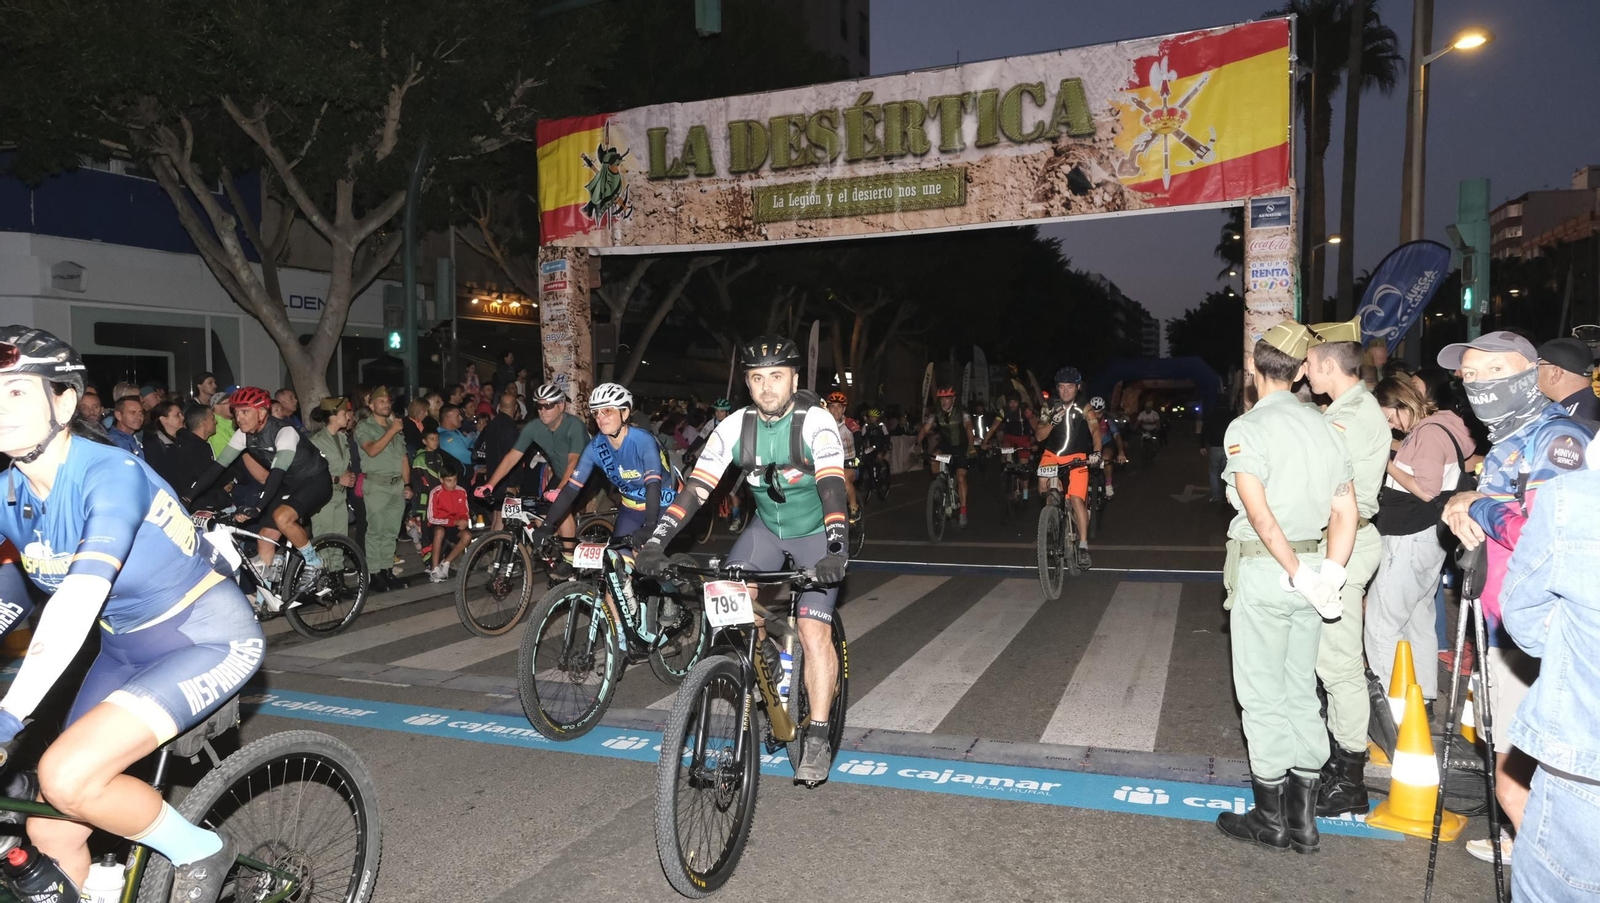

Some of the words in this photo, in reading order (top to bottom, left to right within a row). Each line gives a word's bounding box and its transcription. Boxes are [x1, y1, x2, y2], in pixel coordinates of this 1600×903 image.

[648, 125, 717, 180] LA
[728, 77, 1097, 173] DESÉRTICA
[773, 194, 785, 208] La
[788, 189, 821, 209] Legión
[827, 192, 835, 206] y
[838, 188, 848, 203] el
[853, 184, 893, 202] desierto
[898, 185, 917, 197] nos
[922, 182, 942, 195] une
[1251, 268, 1289, 278] RENTA
[1405, 270, 1435, 304] JUEGA
[1553, 448, 1580, 461] MINIVAN
[1556, 457, 1575, 467] SERVICE
[1039, 466, 1057, 474] 10134
[579, 547, 601, 560] 7499
[711, 593, 747, 615] 7987
[270, 699, 379, 717] cajamar
[447, 720, 548, 739] cajama
[1442, 745, 1450, 769] Quechua
[897, 768, 1062, 791] cajamar
[971, 784, 1005, 792] CAJA
[1008, 787, 1053, 797] RURAL
